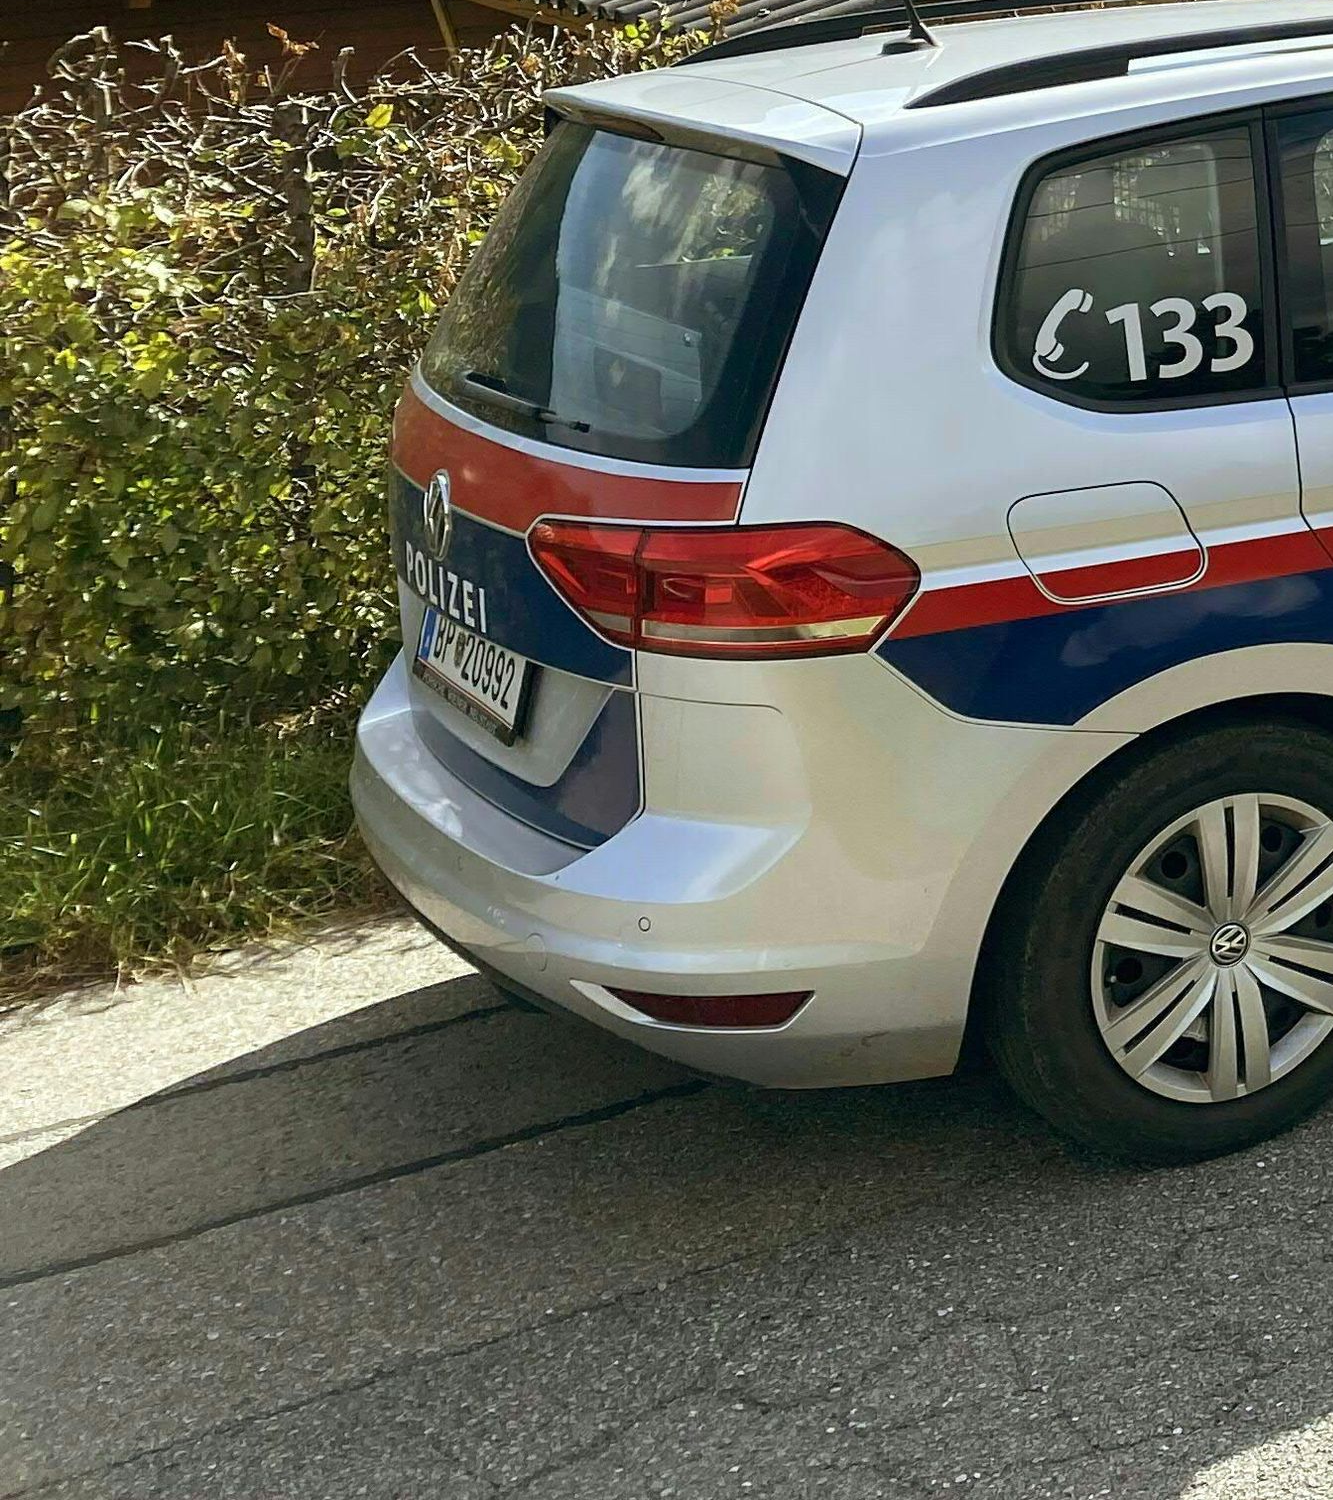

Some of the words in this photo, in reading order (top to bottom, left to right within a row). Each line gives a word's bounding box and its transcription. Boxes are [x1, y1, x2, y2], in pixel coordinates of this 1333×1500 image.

[1104, 291, 1254, 382] 133
[405, 540, 487, 633] POLIZEI
[433, 614, 456, 664] BP
[460, 635, 515, 710] 20992
